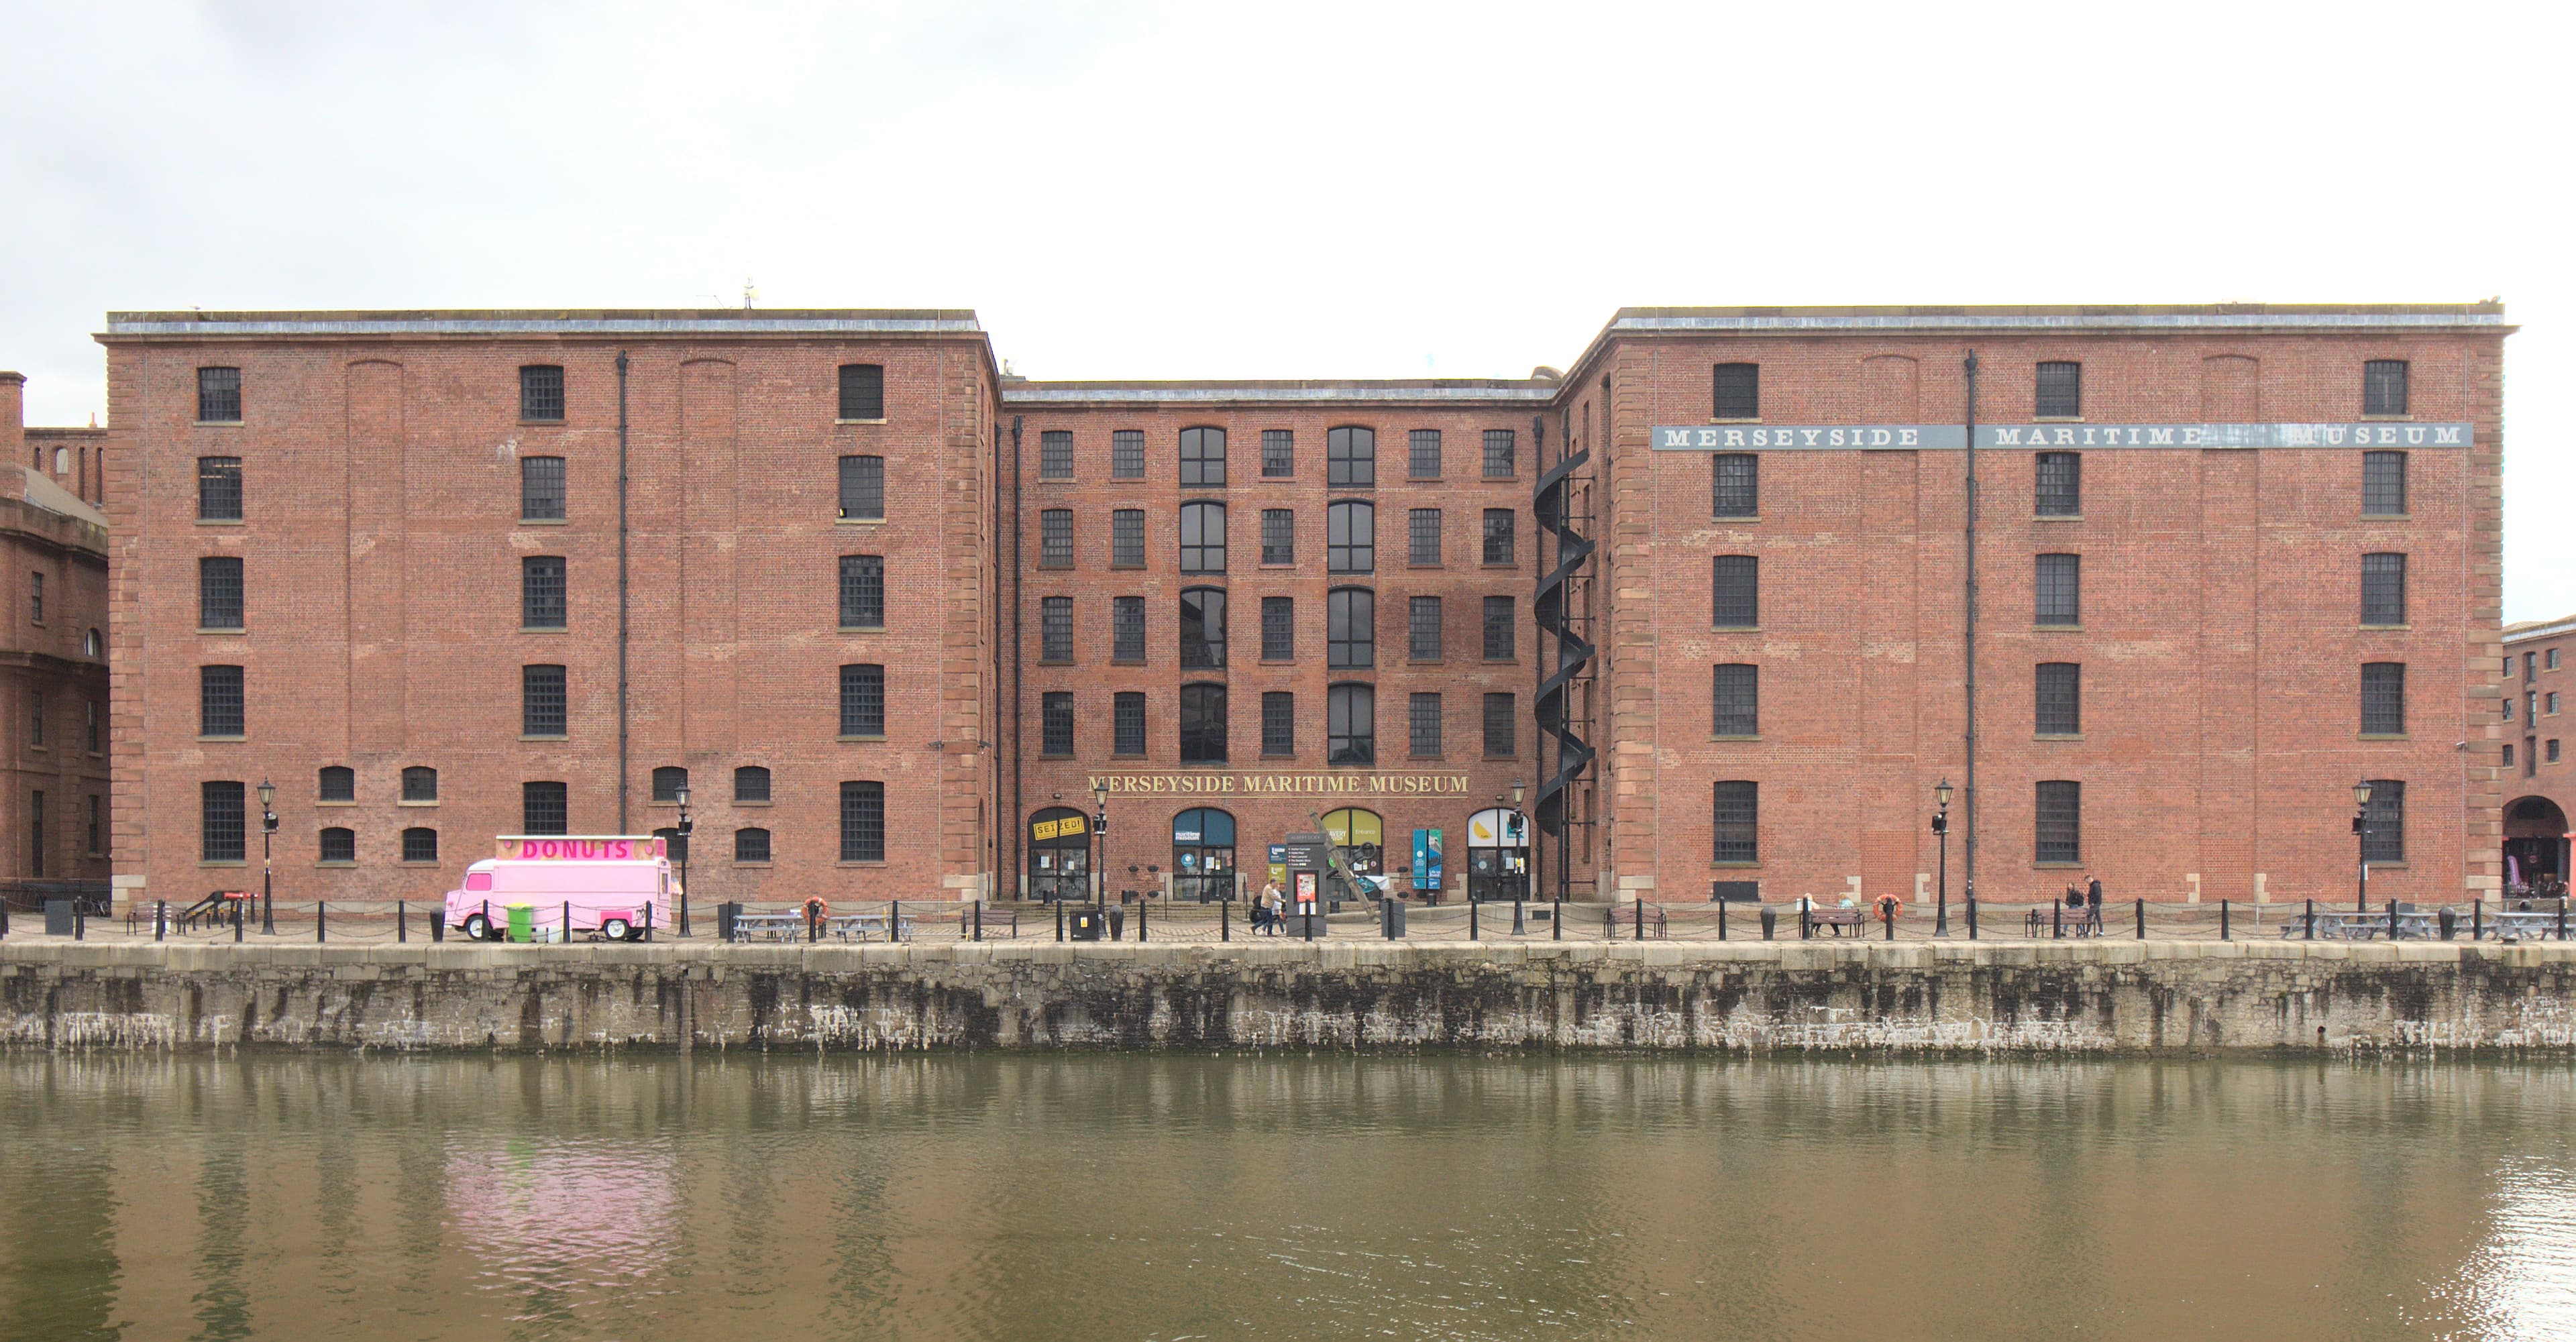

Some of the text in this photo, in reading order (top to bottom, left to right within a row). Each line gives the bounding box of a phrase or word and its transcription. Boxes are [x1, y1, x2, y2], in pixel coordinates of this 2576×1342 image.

[1664, 427, 2461, 447] MERSEYSIDE MARITIME MUSEUM
[1087, 775, 1468, 793] MERSEYSIDE MARITIME MUSEUM
[523, 840, 627, 858] DONUTS
